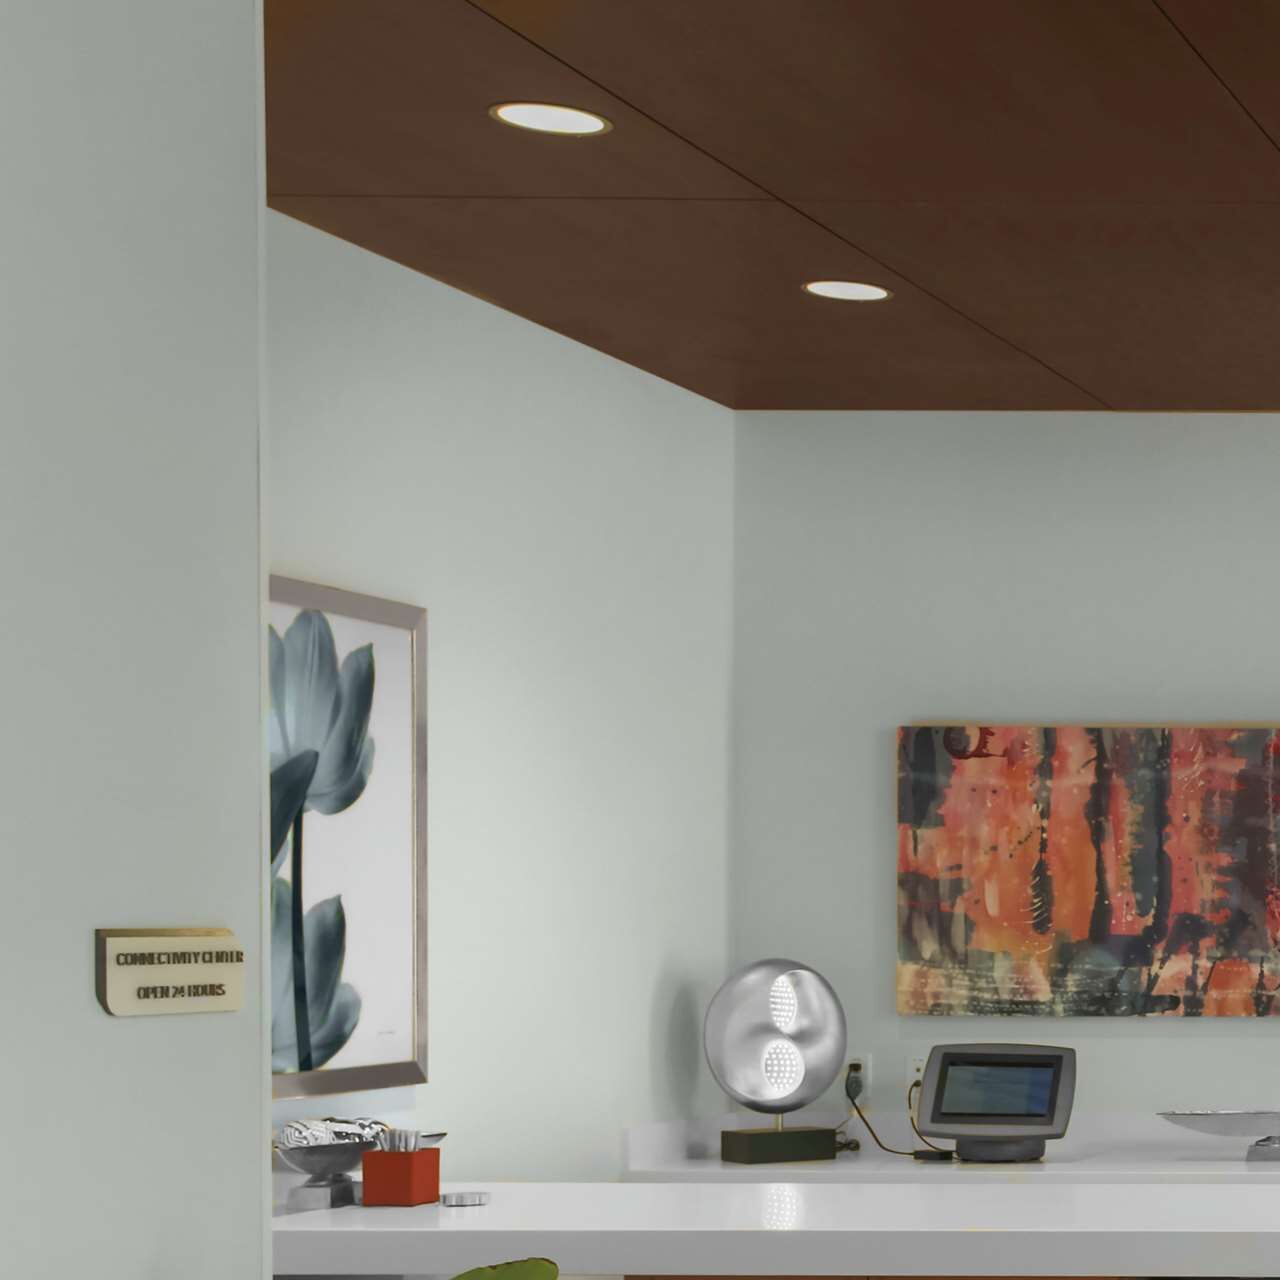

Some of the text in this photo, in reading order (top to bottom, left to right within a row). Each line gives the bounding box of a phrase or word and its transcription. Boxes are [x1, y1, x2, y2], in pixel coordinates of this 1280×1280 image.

[116, 951, 244, 967] CONNECTIVITY CENTER
[137, 986, 170, 1000] OPEN
[187, 984, 226, 997] HOURS
